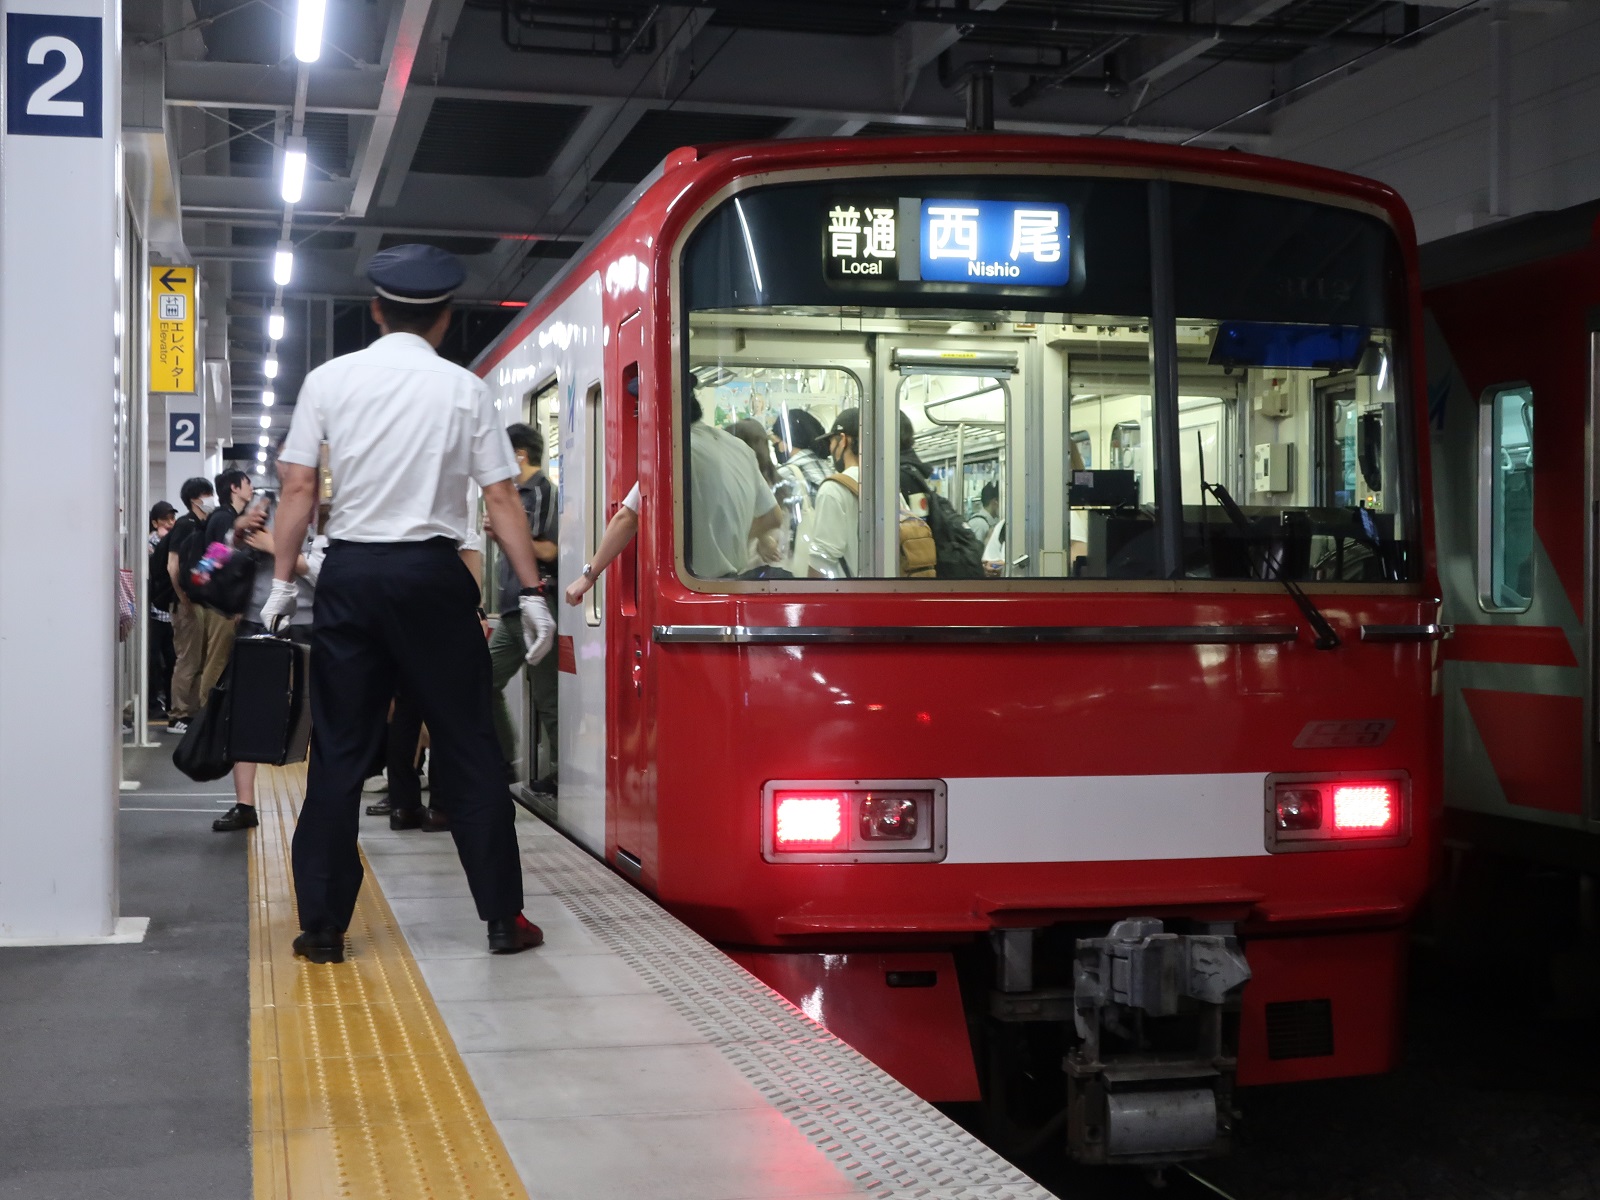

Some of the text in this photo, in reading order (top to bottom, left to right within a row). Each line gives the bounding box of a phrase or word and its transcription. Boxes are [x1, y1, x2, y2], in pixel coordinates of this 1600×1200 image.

[26, 35, 84, 117] 2
[828, 205, 896, 259] 普通
[927, 206, 1061, 263] 西尾
[841, 258, 883, 275] Local
[967, 260, 1021, 277] Nishio
[159, 322, 169, 364] Elevator
[170, 322, 185, 389] エレベーター
[174, 418, 196, 447] 2
